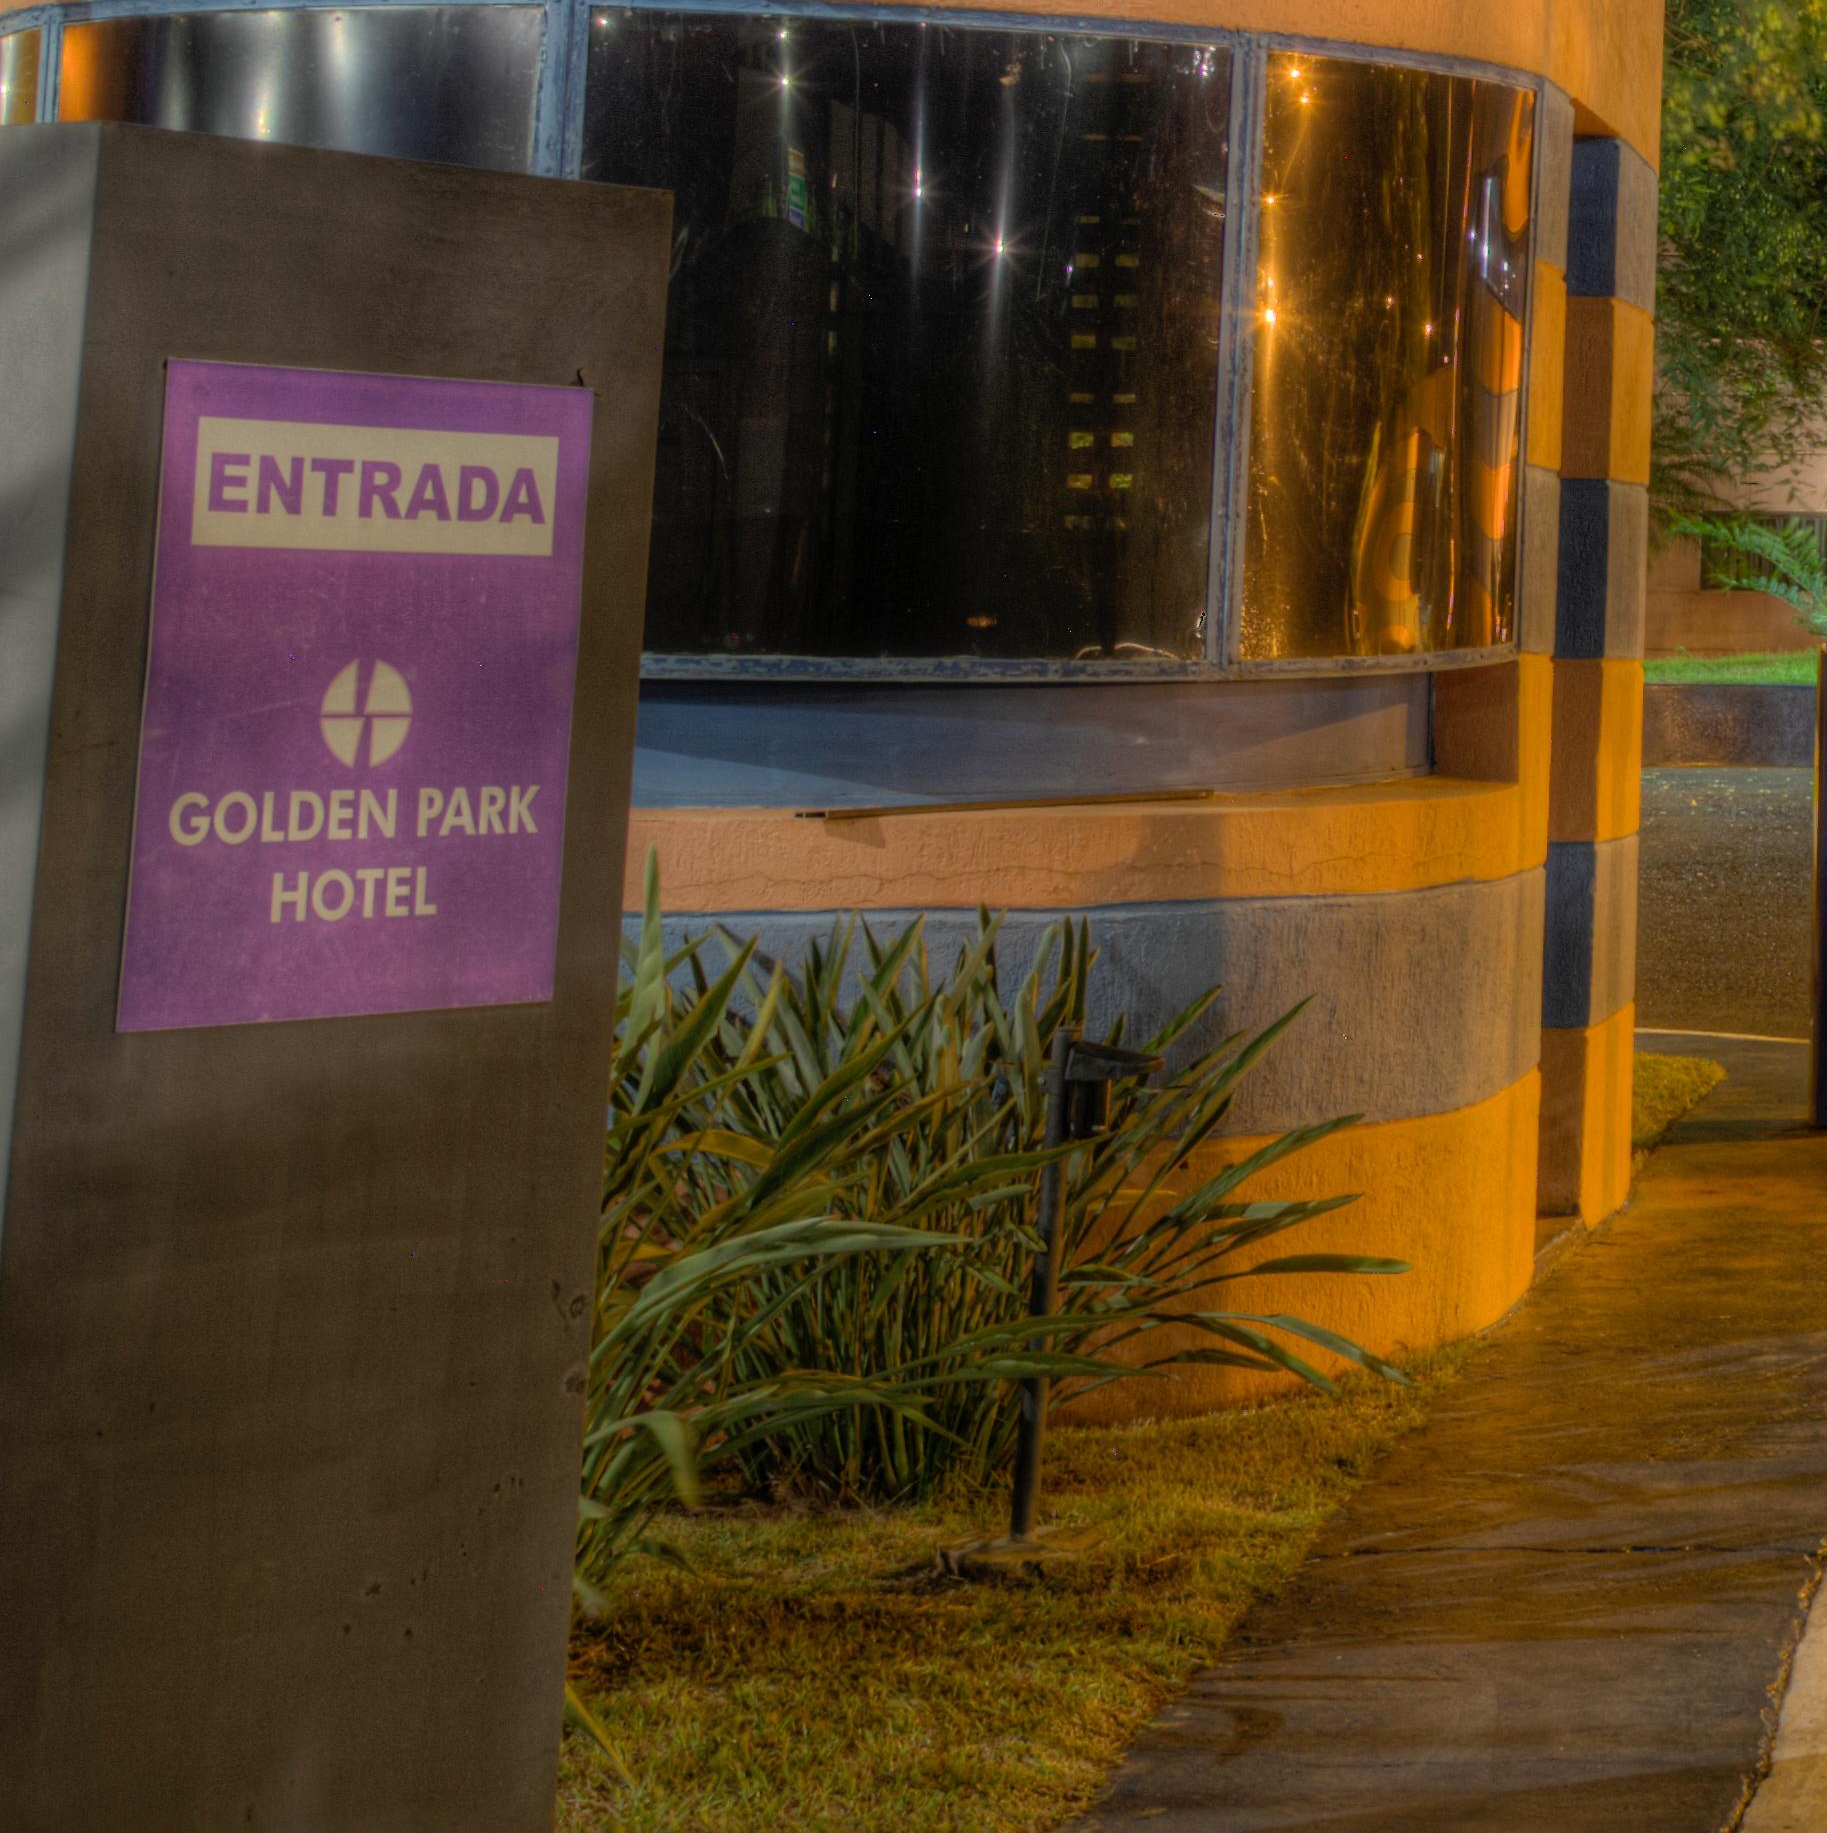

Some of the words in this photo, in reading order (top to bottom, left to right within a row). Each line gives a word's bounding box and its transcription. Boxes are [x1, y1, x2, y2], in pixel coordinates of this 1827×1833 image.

[207, 451, 547, 526] ENTRADA
[169, 788, 398, 847] GOLDEN
[416, 784, 541, 838] PARK
[270, 866, 438, 924] HOTEL
